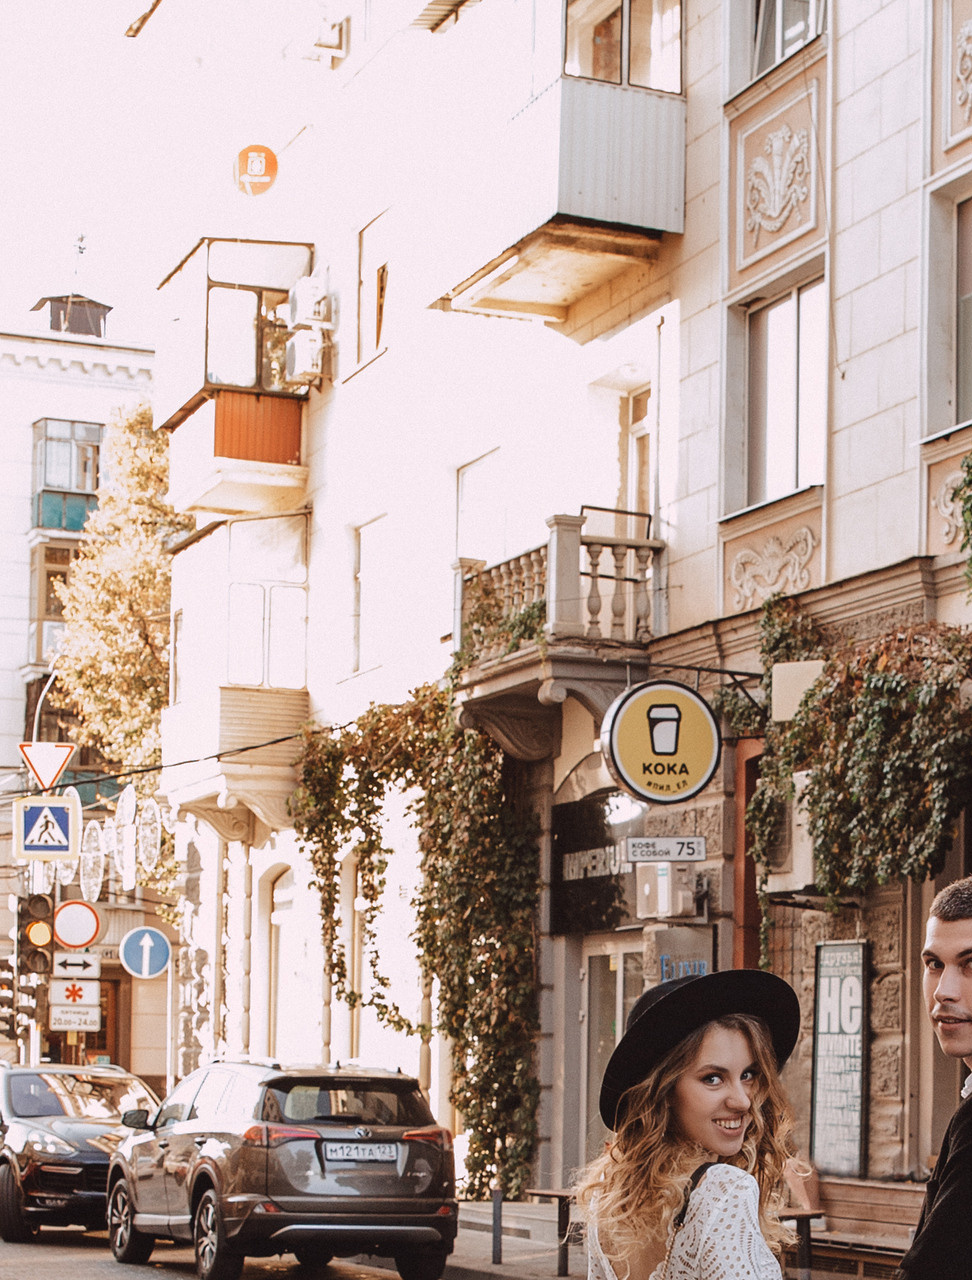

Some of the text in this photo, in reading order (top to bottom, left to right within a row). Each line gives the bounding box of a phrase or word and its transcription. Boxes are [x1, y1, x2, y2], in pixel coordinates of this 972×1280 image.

[642, 762, 689, 775] КОКА
[640, 847, 671, 857] СОБОЙ
[676, 841, 695, 856] 75
